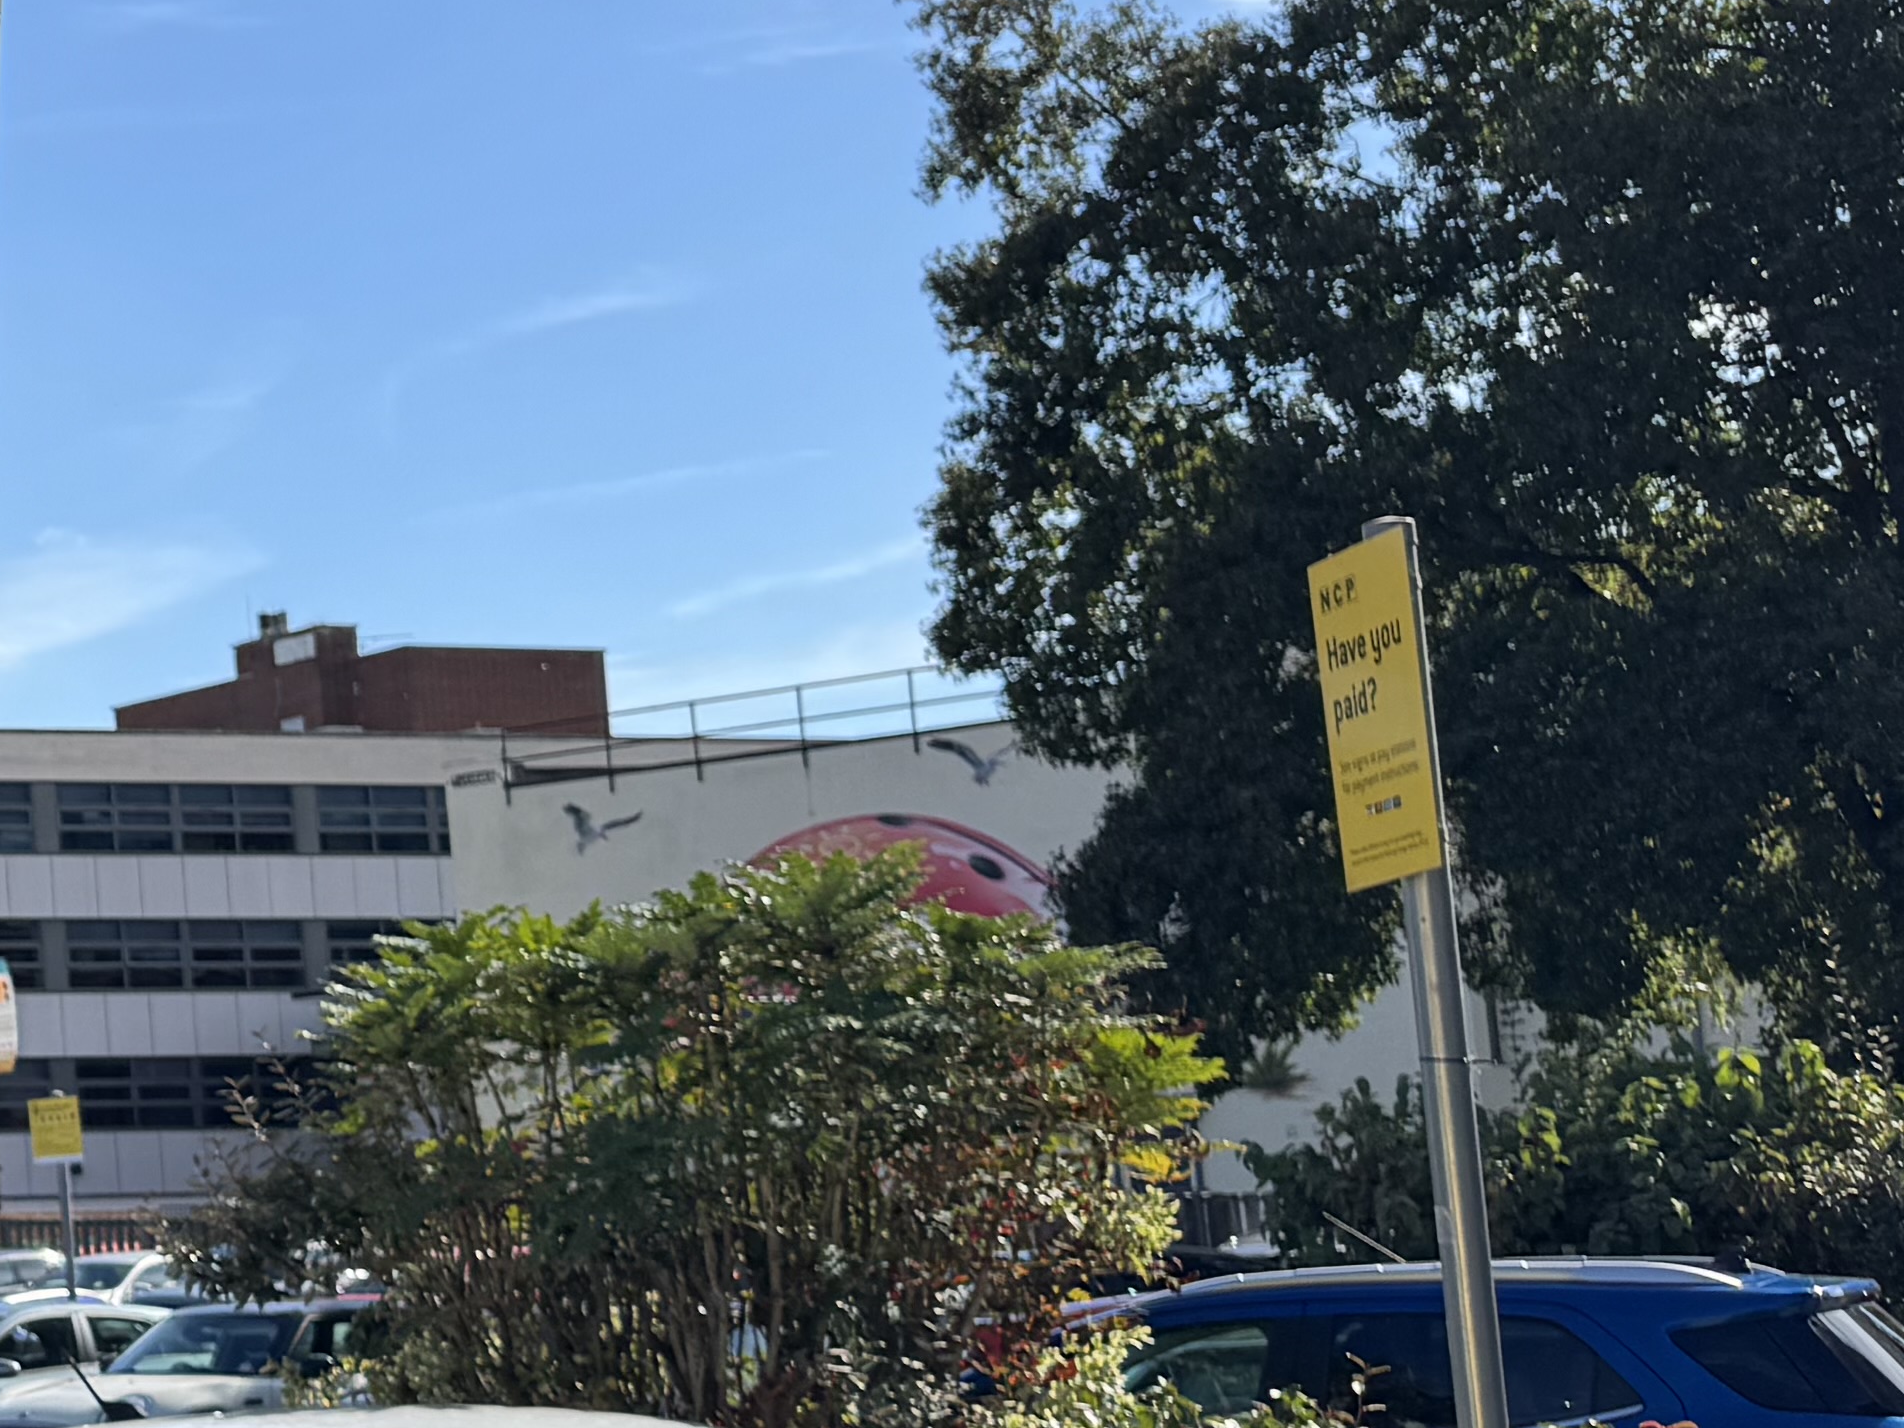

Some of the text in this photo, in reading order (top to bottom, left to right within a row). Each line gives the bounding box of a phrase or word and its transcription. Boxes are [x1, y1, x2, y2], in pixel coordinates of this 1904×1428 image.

[1320, 578, 1357, 613] NCP
[1326, 618, 1402, 673] Have you
[1334, 676, 1378, 735] paid?
